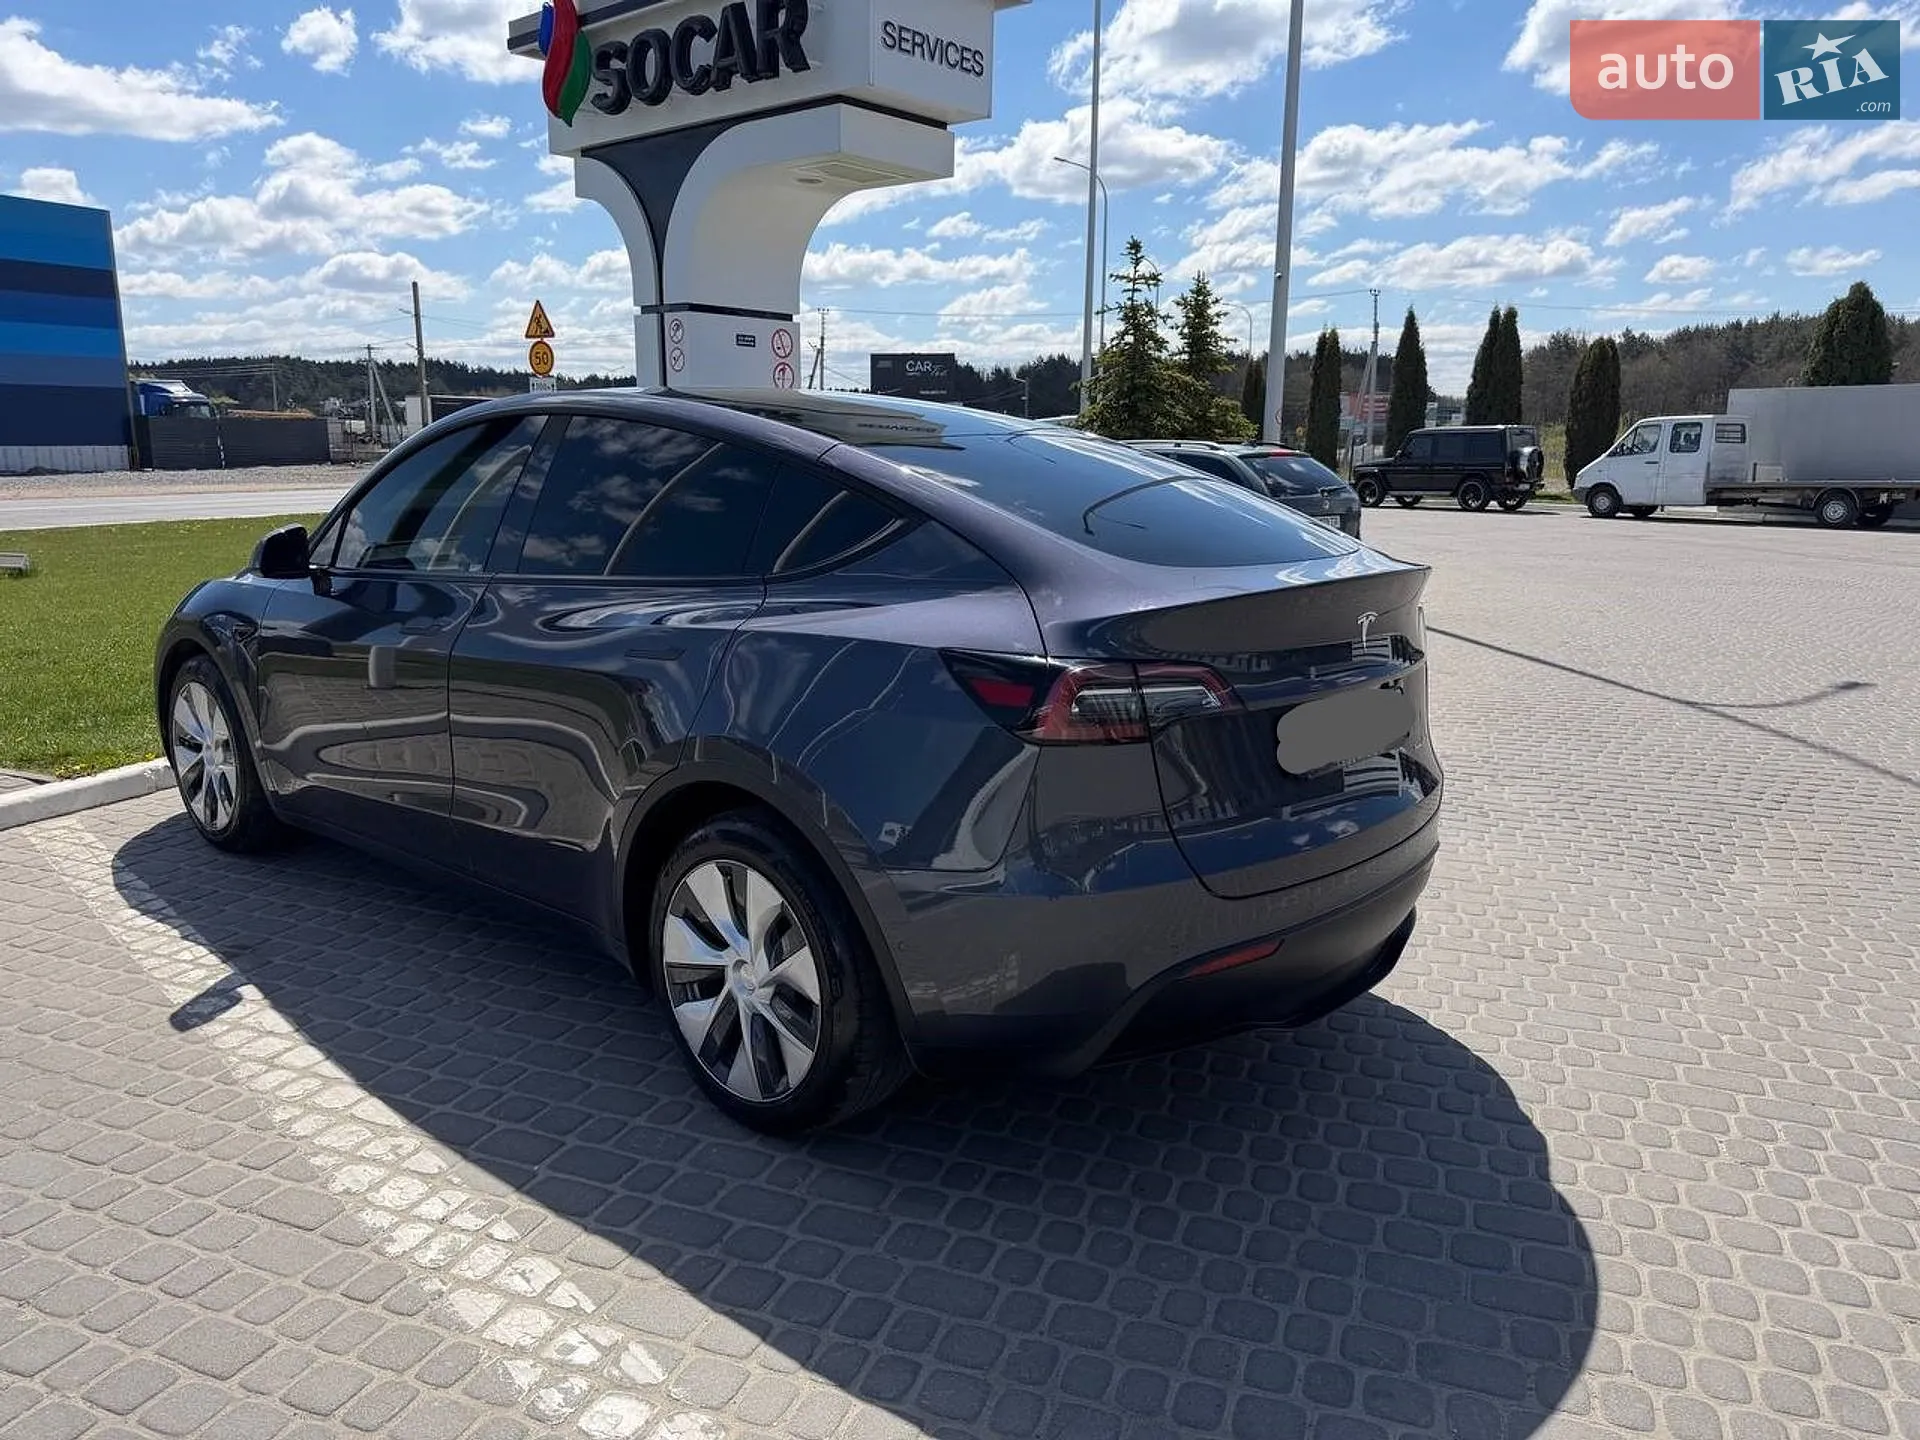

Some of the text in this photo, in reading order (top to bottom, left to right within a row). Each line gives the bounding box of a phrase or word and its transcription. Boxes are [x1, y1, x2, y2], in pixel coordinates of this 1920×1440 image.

[591, 0, 811, 115] SOCAR
[881, 21, 984, 77] SERVICES
[534, 351, 549, 365] 50
[905, 360, 933, 372] CAR
